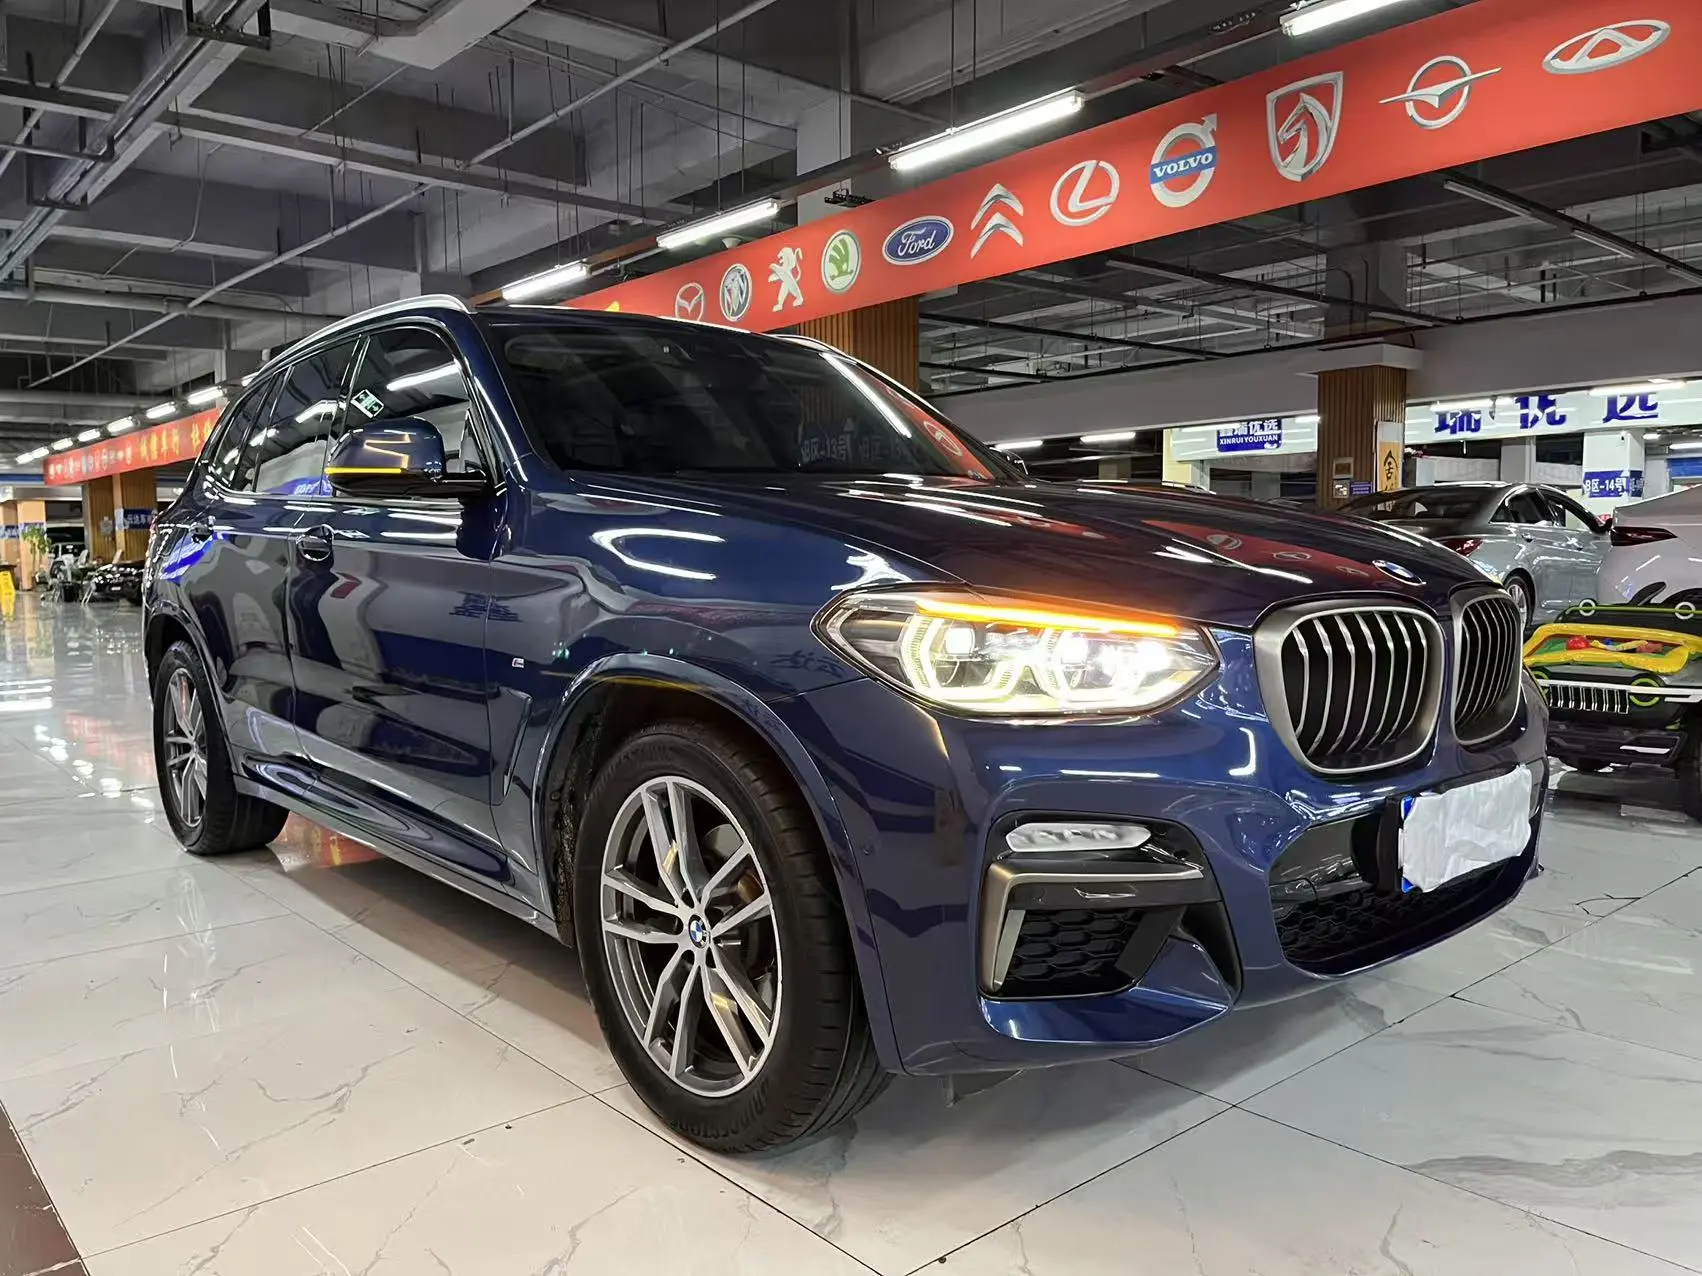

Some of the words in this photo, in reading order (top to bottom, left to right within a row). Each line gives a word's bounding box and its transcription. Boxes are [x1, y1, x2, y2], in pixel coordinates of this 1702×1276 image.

[1153, 153, 1213, 177] VOLVO
[897, 227, 936, 256] Ford
[1219, 437, 1244, 445] XINRUI
[1244, 434, 1278, 443] YOUXUAN
